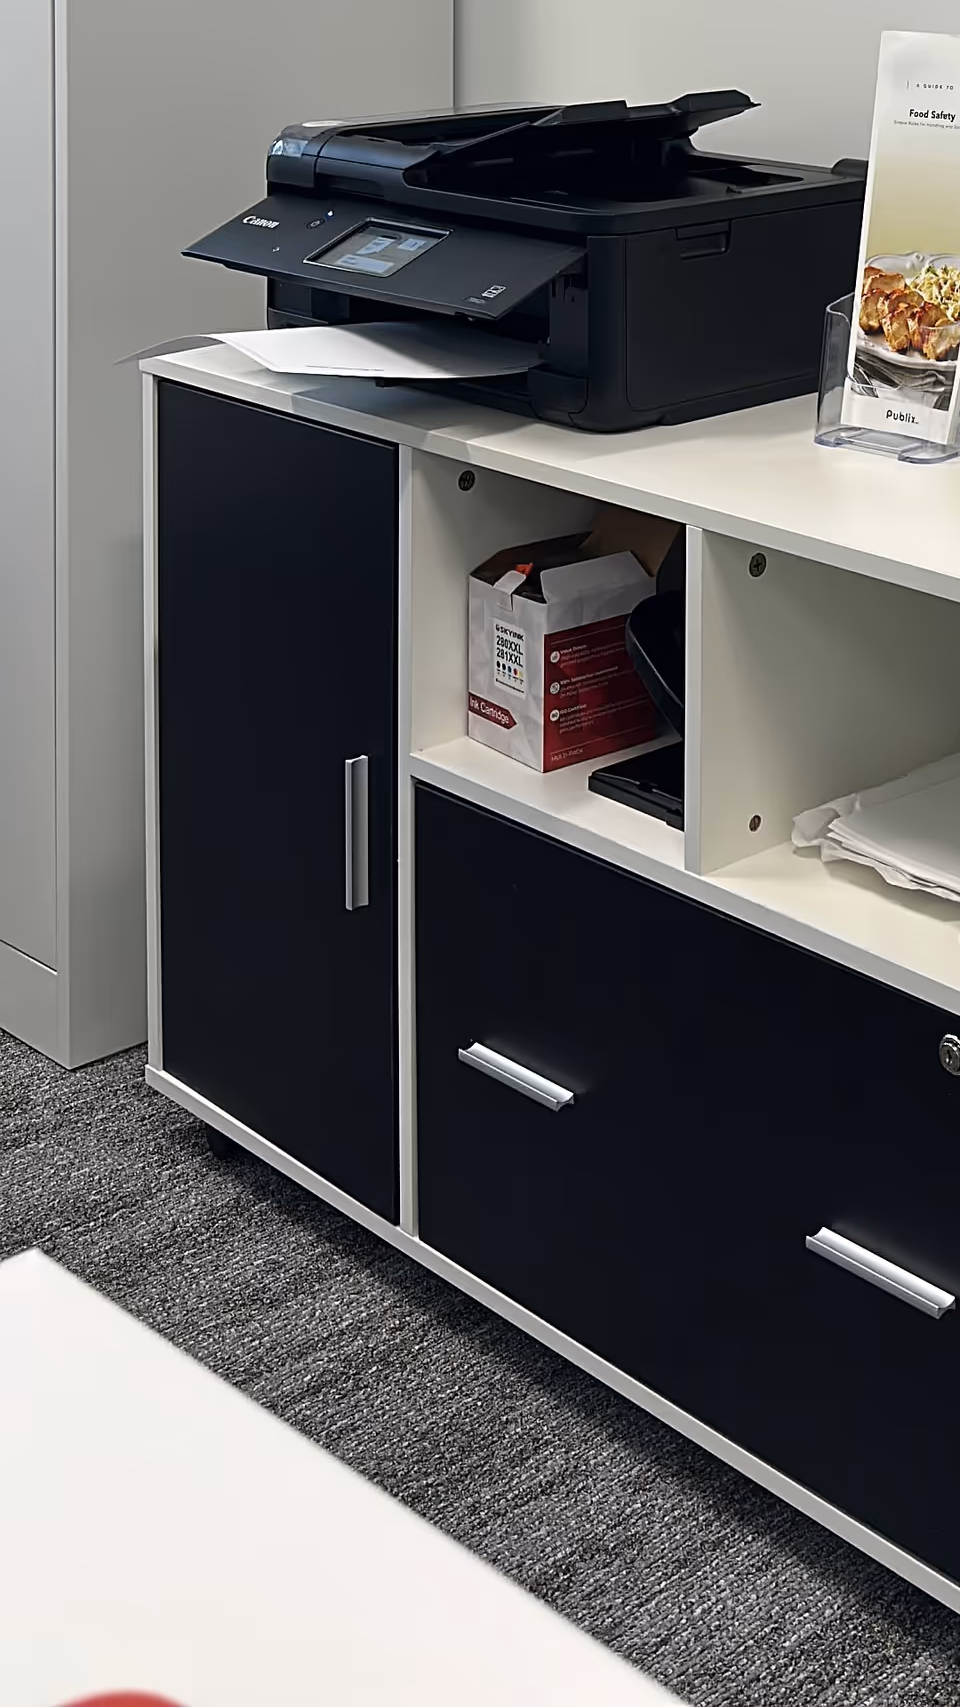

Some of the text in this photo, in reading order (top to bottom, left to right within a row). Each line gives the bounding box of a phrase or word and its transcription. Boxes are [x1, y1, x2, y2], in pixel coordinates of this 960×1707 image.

[909, 109, 955, 122] Food Safety
[242, 215, 280, 229] Canon
[886, 409, 917, 424] Publix
[500, 626, 524, 641] SKYINK
[497, 635, 523, 655] 280XXL
[497, 647, 523, 668] 281XXL
[469, 695, 510, 724] Ink Cartridge
